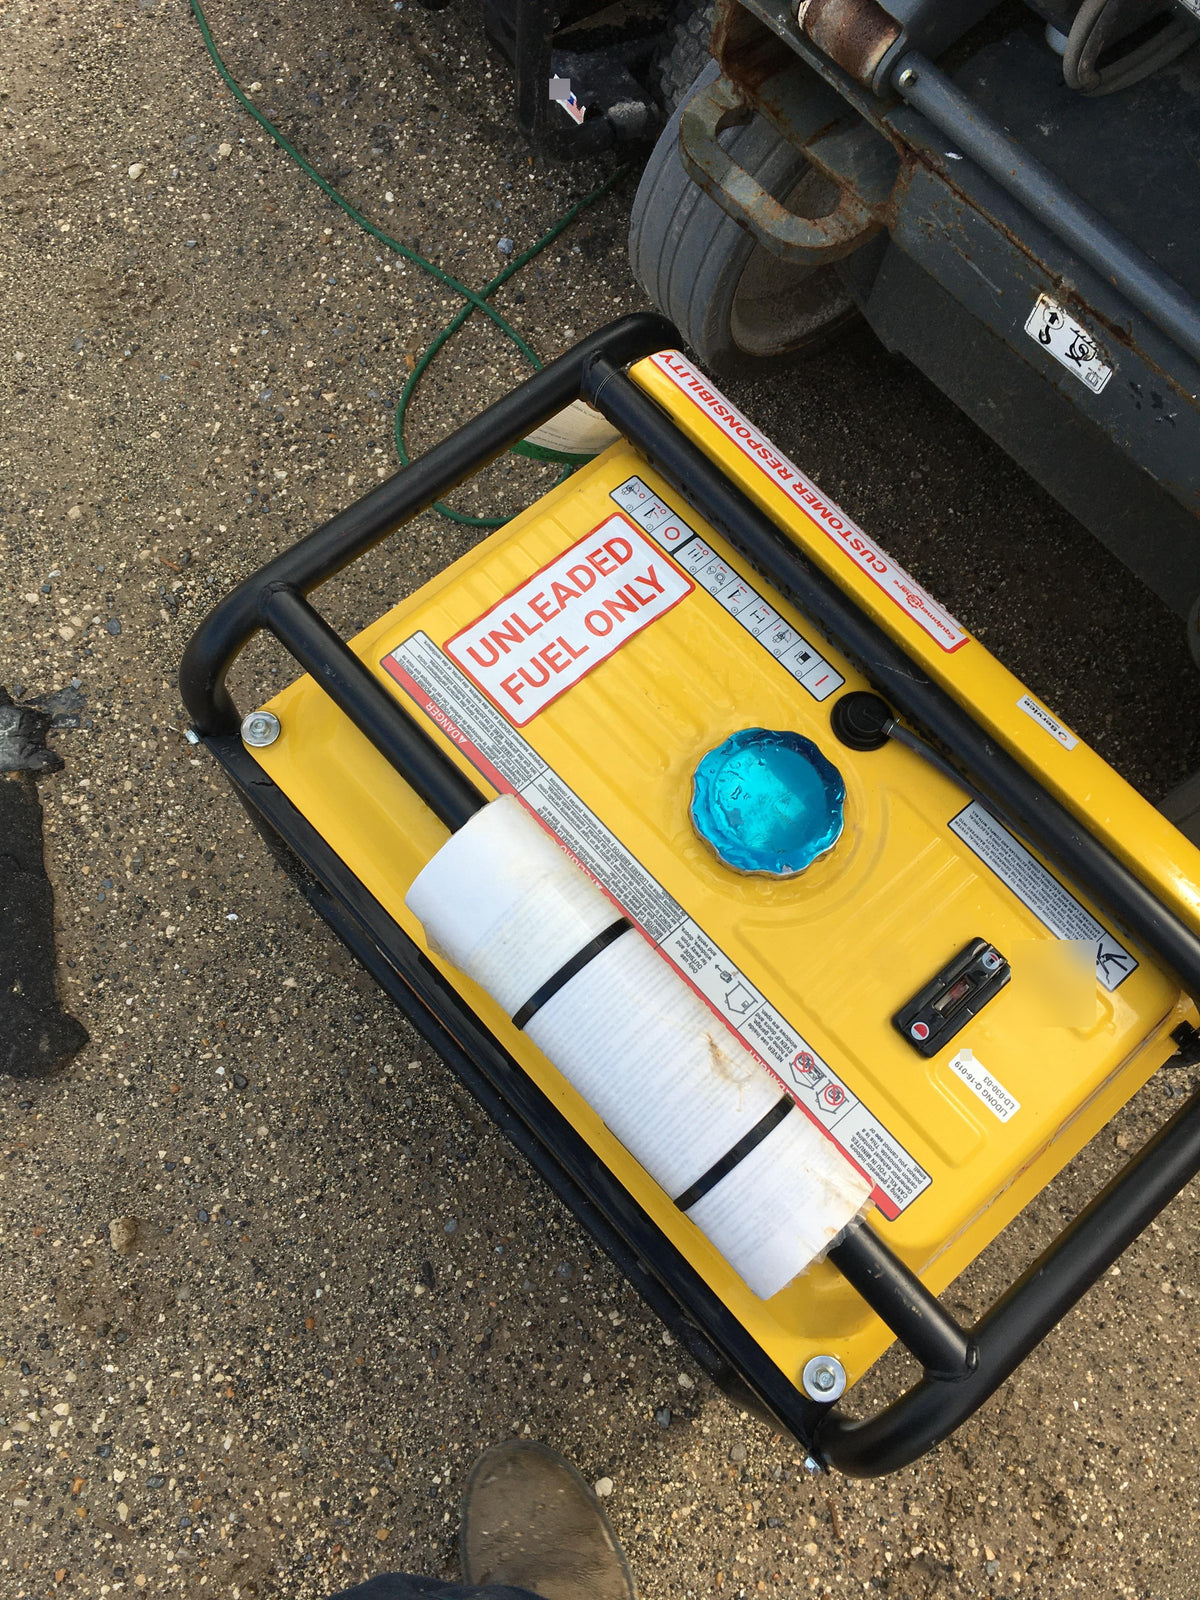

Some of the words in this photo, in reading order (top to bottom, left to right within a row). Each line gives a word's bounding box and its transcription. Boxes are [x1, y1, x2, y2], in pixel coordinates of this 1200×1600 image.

[659, 355, 792, 480] RESPONSIBILITY
[792, 483, 887, 573] CUSTOMER
[467, 538, 632, 667] UNLEADED
[894, 580, 955, 640] EquipmentShare
[500, 638, 588, 704] FUEL
[585, 565, 664, 636] ONLY
[424, 701, 460, 738] DANGER
[953, 1060, 984, 1091] Q-16-019
[980, 1088, 1008, 1117] LIDONG
[981, 1075, 1015, 1109] LD-030-03
